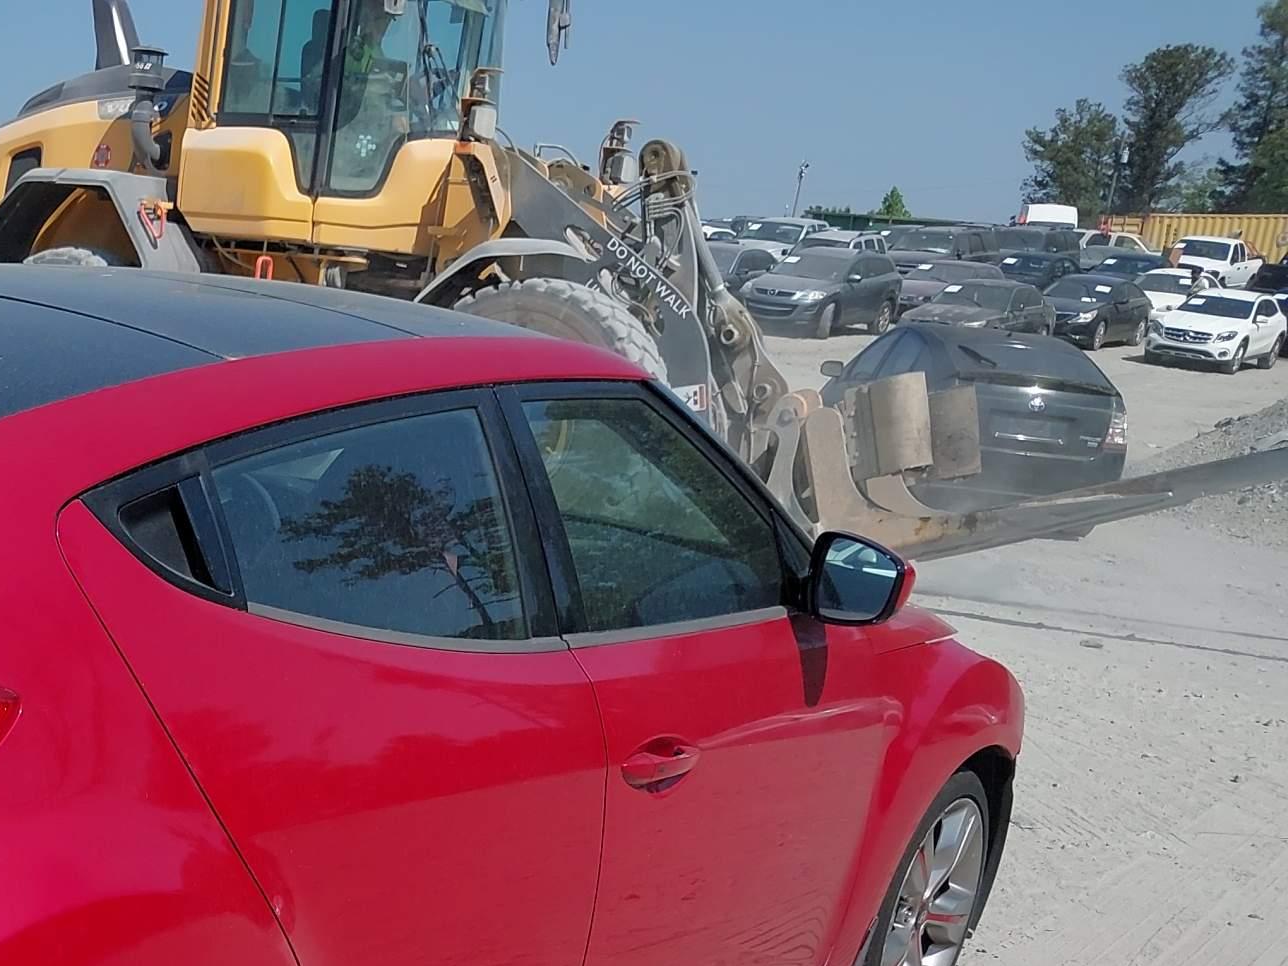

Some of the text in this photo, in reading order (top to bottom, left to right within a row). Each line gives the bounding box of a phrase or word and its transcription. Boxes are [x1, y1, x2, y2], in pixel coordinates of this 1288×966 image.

[607, 238, 692, 319] DO NOT WALK
